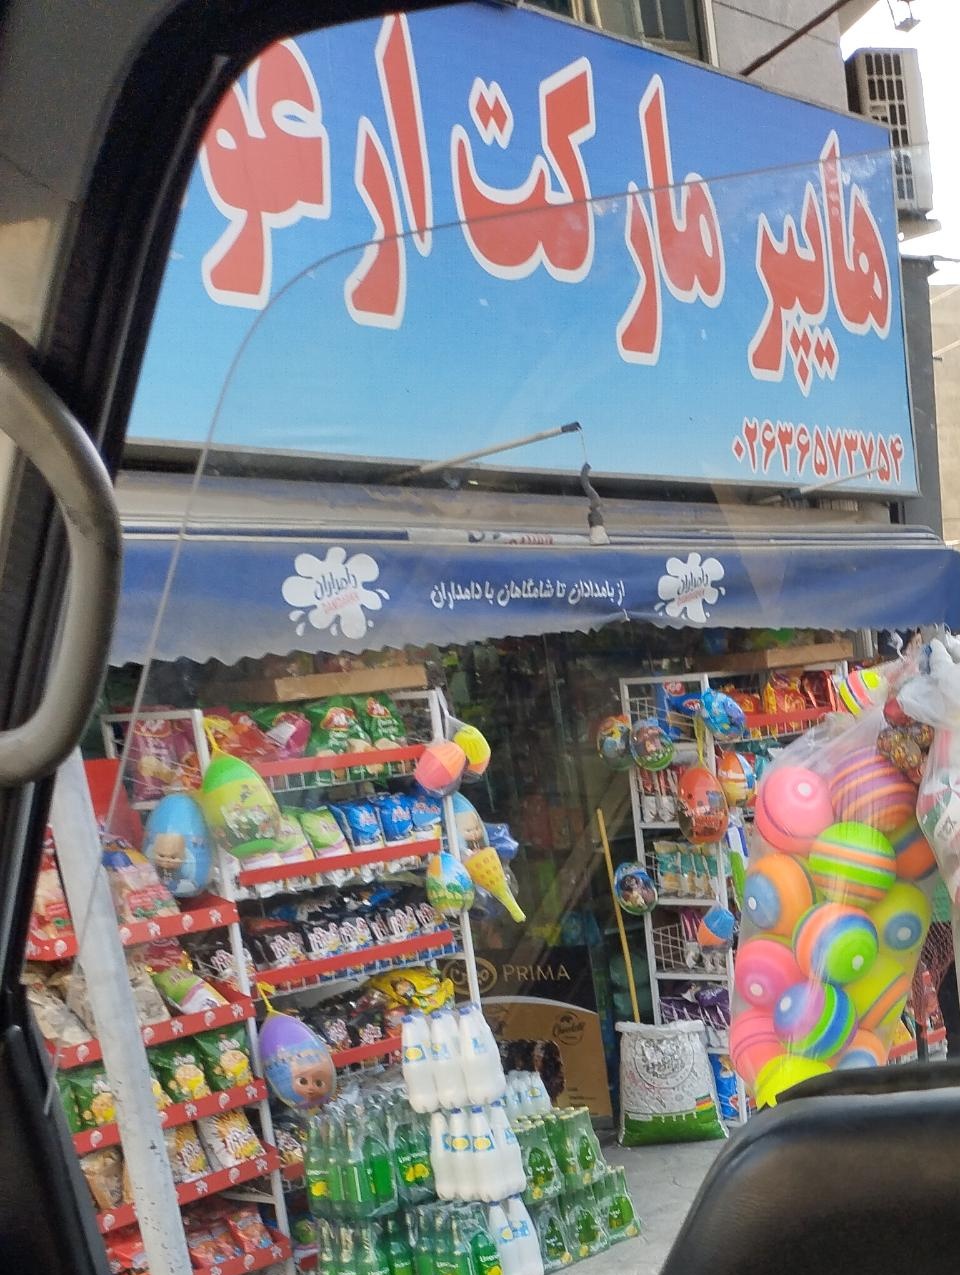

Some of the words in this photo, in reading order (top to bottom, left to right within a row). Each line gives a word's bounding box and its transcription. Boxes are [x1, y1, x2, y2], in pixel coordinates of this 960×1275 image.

[451, 56, 726, 366] مارکت
[748, 129, 891, 398] هایپر
[430, 580, 482, 610] دامداران
[485, 580, 494, 605] با
[497, 577, 554, 607] شامگاهان
[556, 579, 567, 598] تا
[568, 579, 614, 605] بامدادان
[617, 579, 625, 606] از
[501, 963, 572, 983] PRIMA
